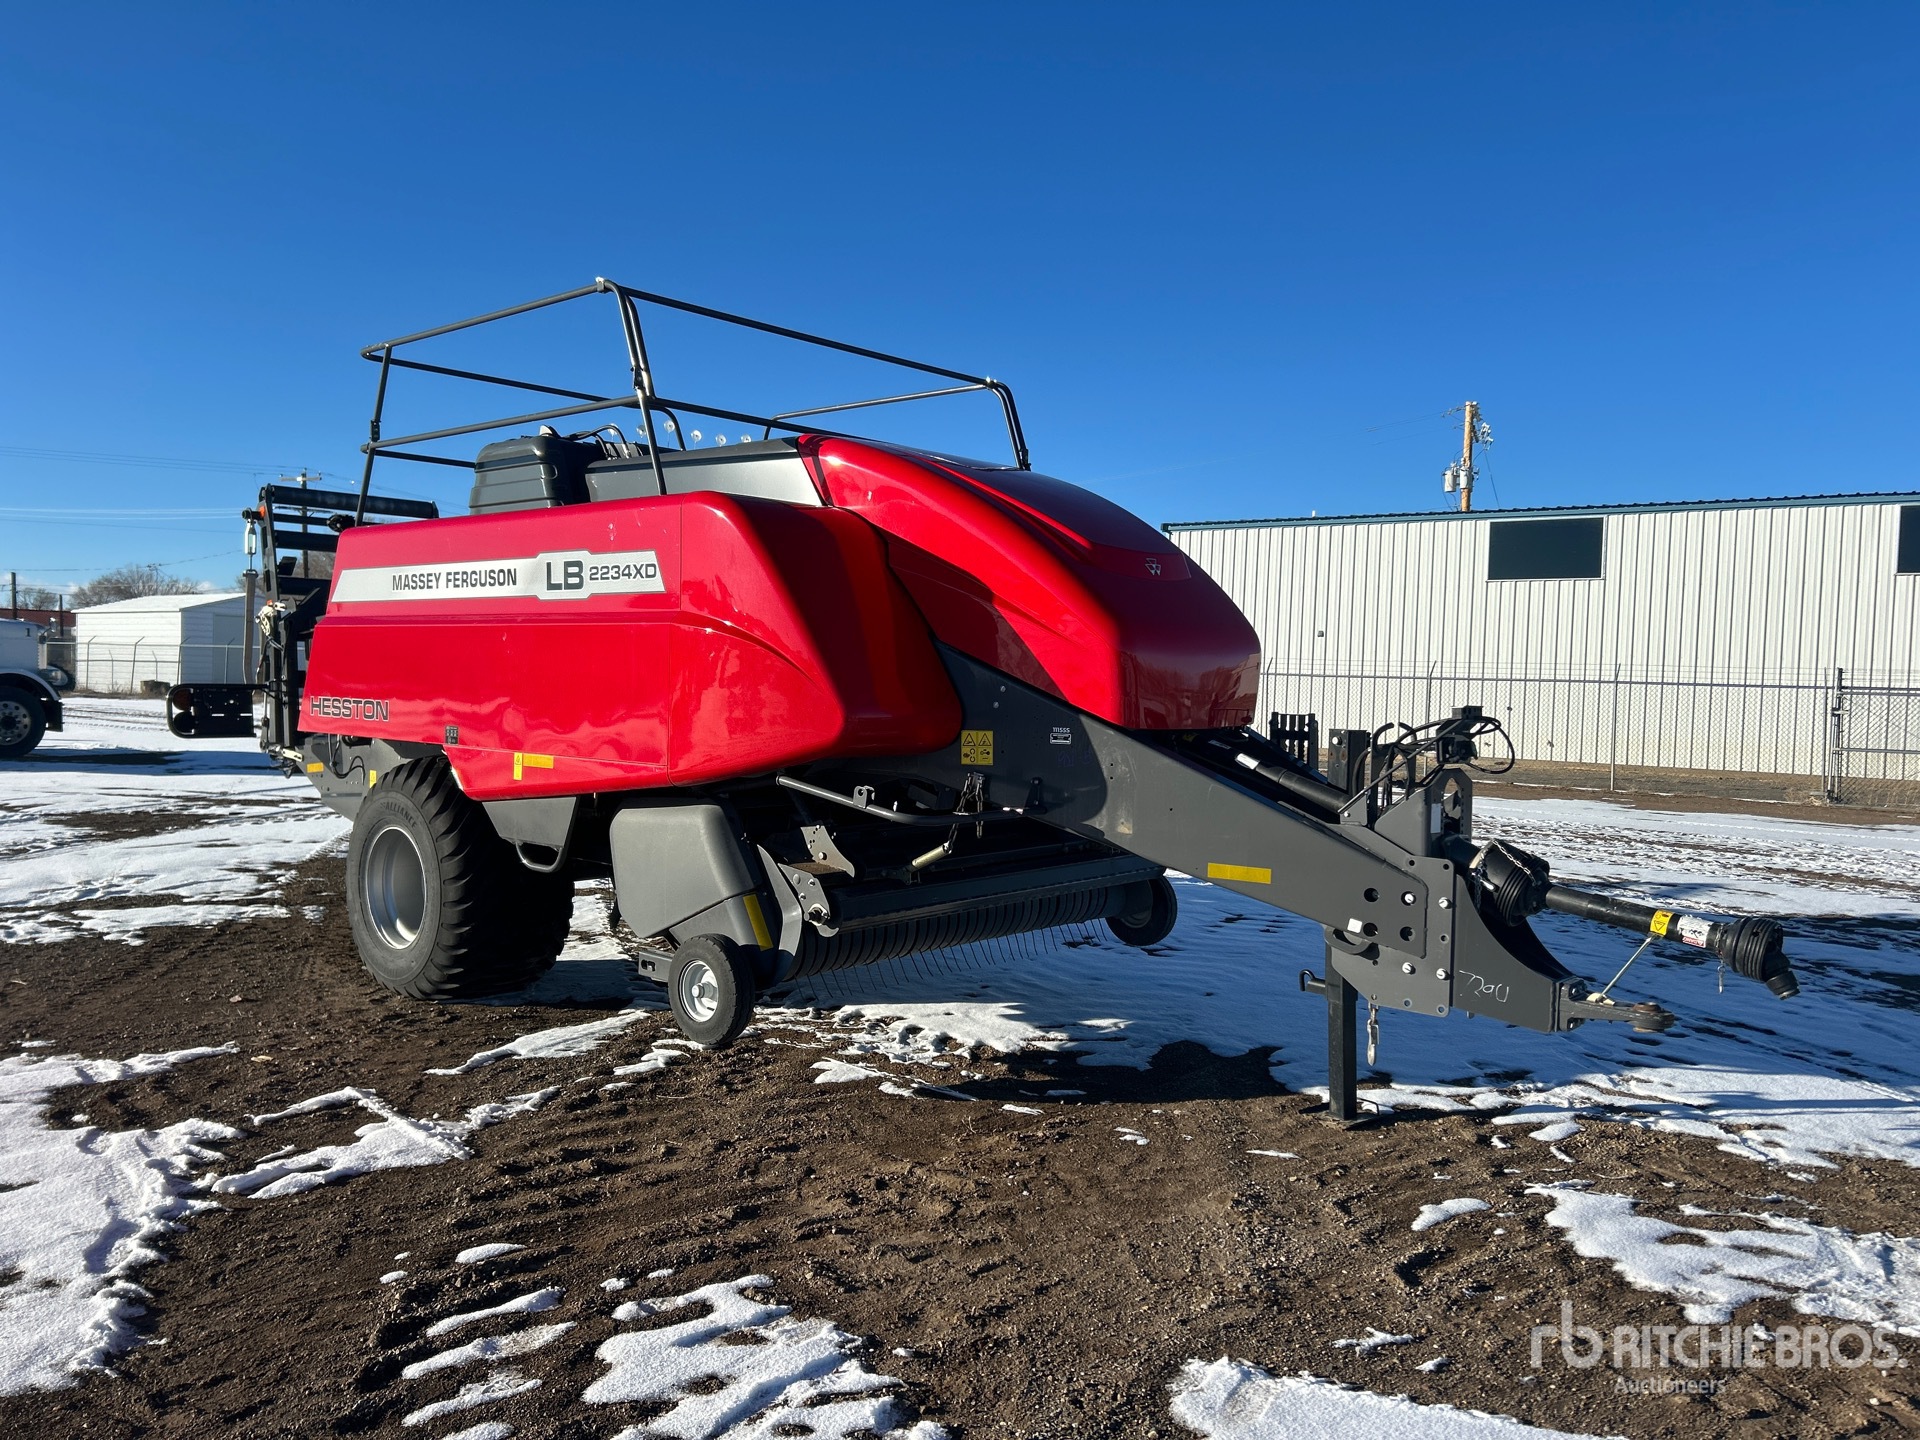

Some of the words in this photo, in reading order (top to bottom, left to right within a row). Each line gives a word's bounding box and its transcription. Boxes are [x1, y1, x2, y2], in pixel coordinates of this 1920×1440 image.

[392, 571, 441, 591] MASSEY
[445, 568, 517, 588] FERGUSON
[546, 560, 584, 591] LB
[588, 563, 657, 581] 2234XD
[310, 696, 389, 721] HESSTON
[385, 801, 417, 829] ALLIANCE
